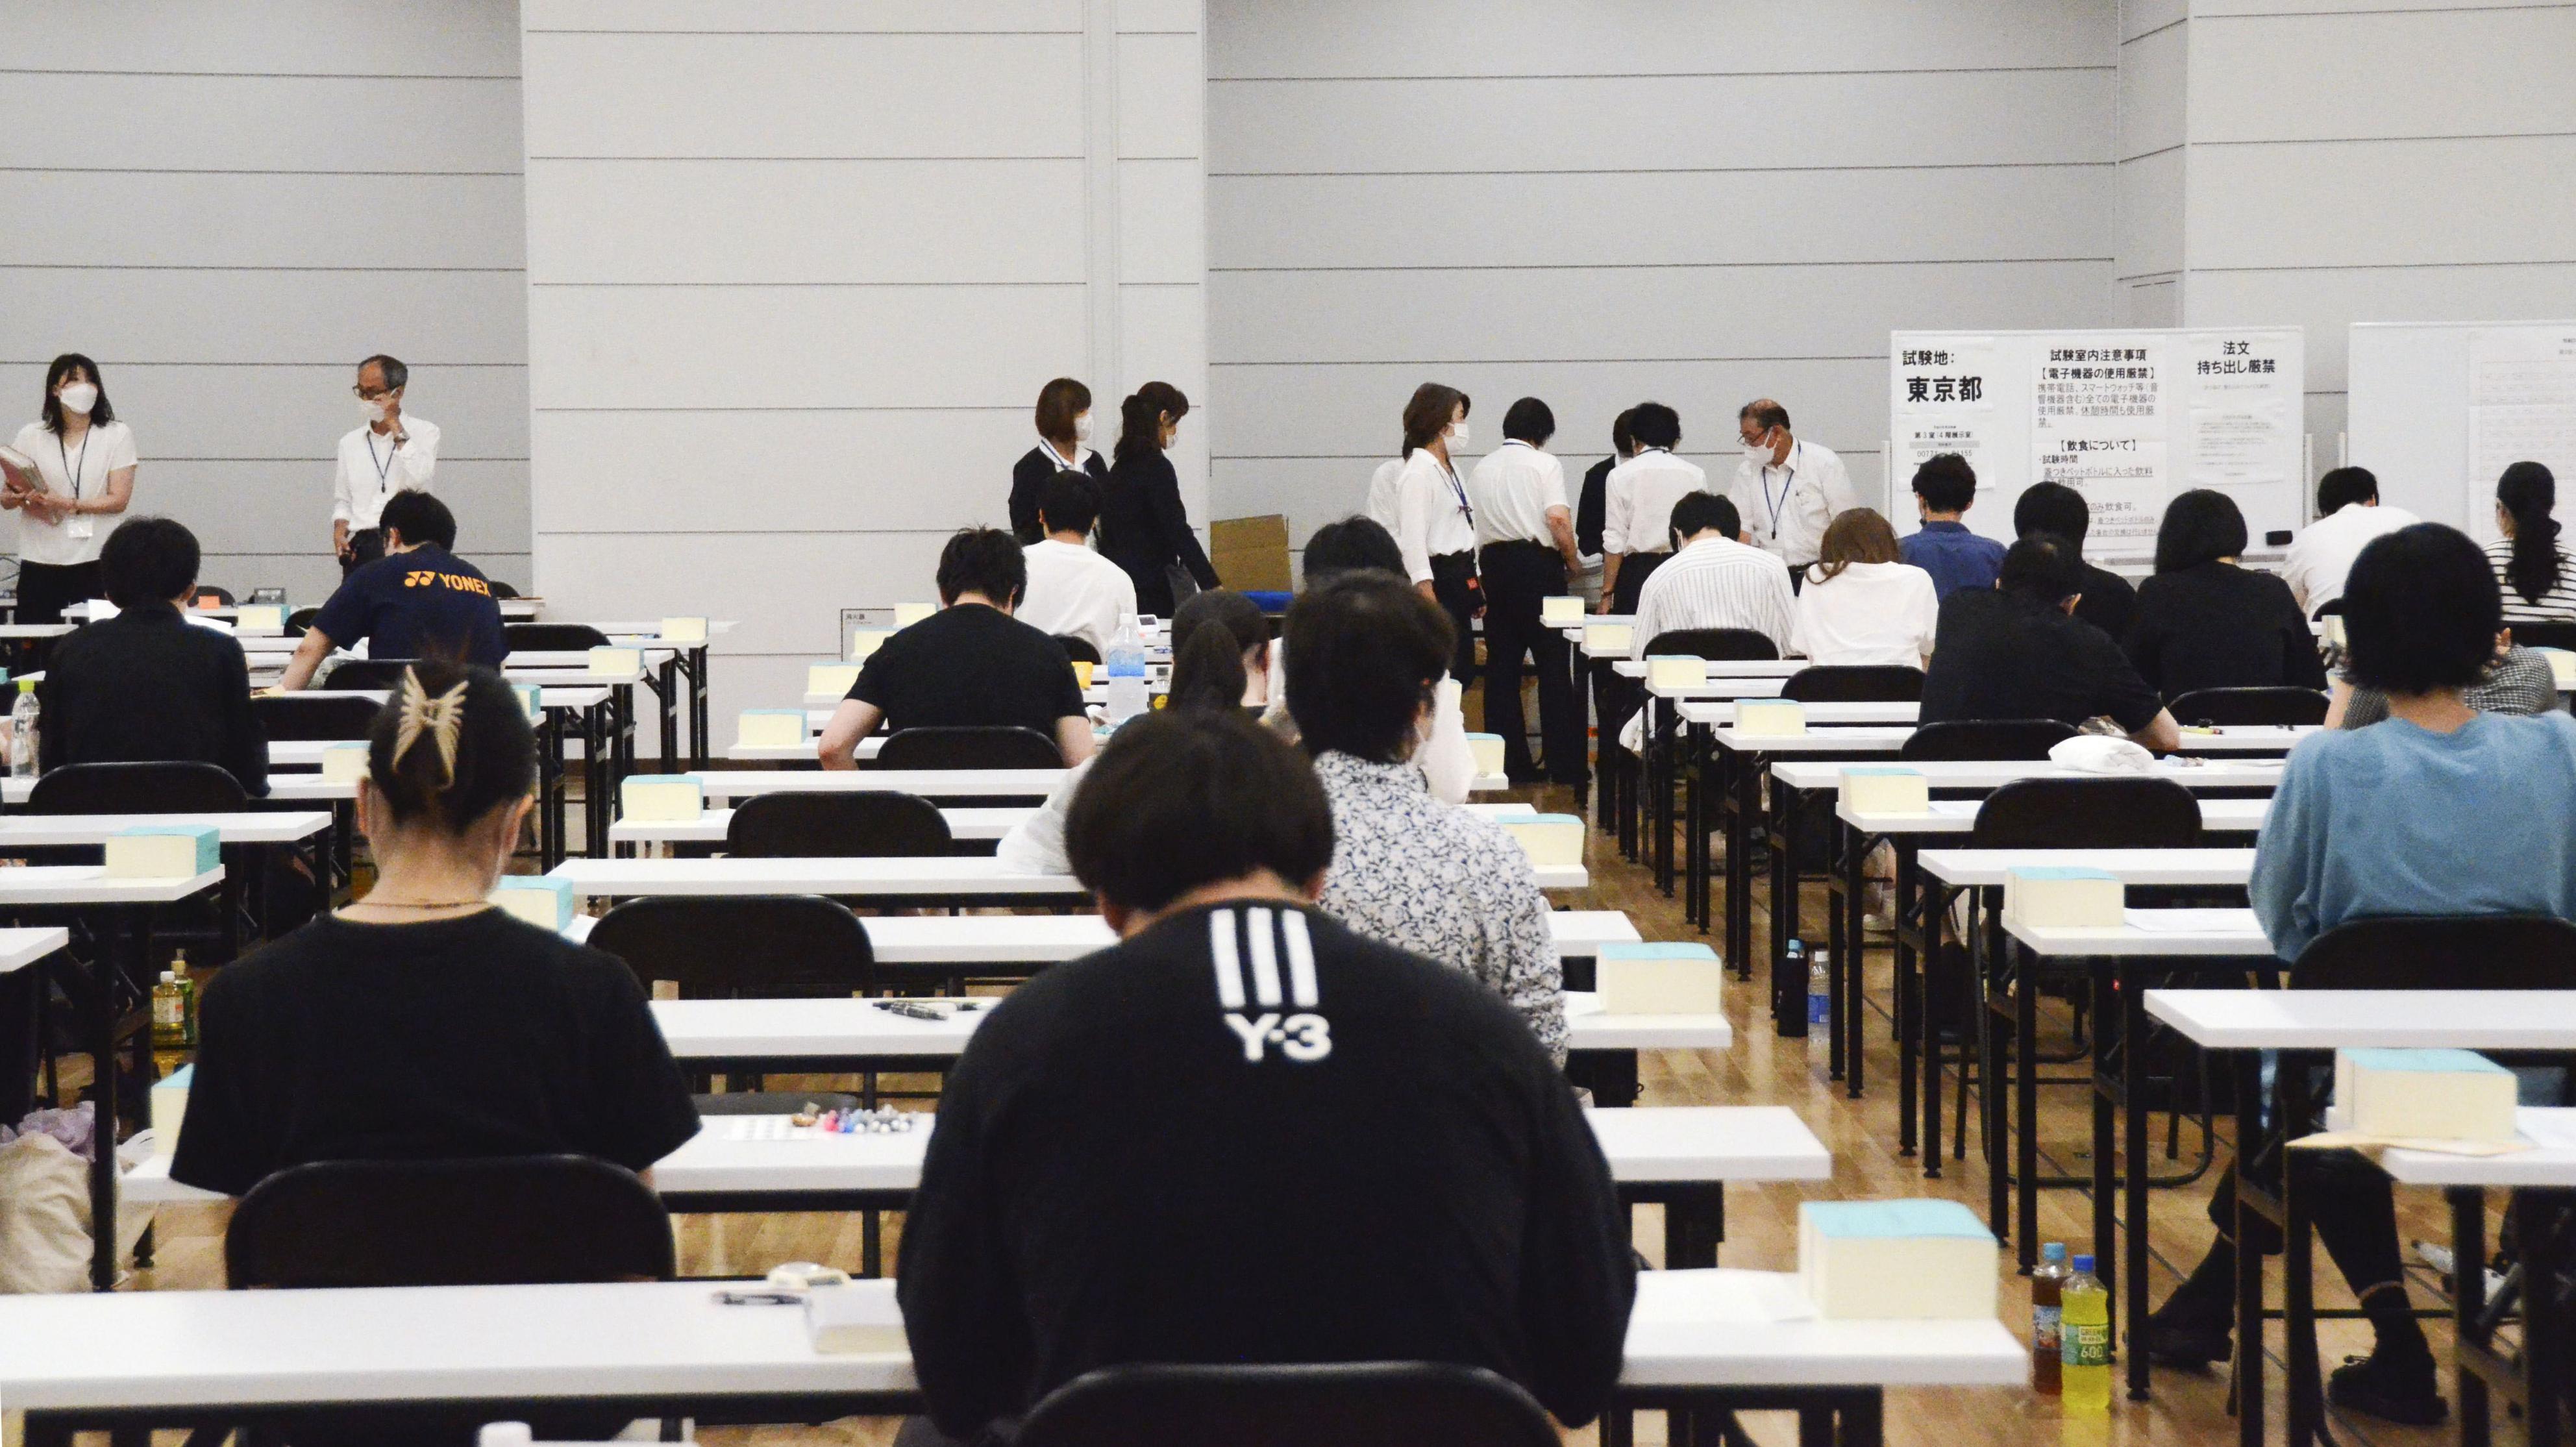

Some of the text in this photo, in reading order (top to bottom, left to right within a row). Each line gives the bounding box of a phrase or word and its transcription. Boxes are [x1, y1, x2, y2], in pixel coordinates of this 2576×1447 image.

[2223, 340, 2250, 355] 法文
[1902, 350, 1955, 366] 試験地:
[2050, 349, 2147, 362] 試験室内注意事項
[2042, 367, 2154, 380] 【電子機器の使用厳禁】
[2197, 358, 2275, 375] 持ち出し厳禁
[1906, 375, 1983, 402] 東京都
[2061, 439, 2136, 451] 【飲食について】
[438, 573, 491, 597] YONEX
[1223, 1013, 1332, 1061] Y-3
[2081, 1346, 2103, 1358] 600
